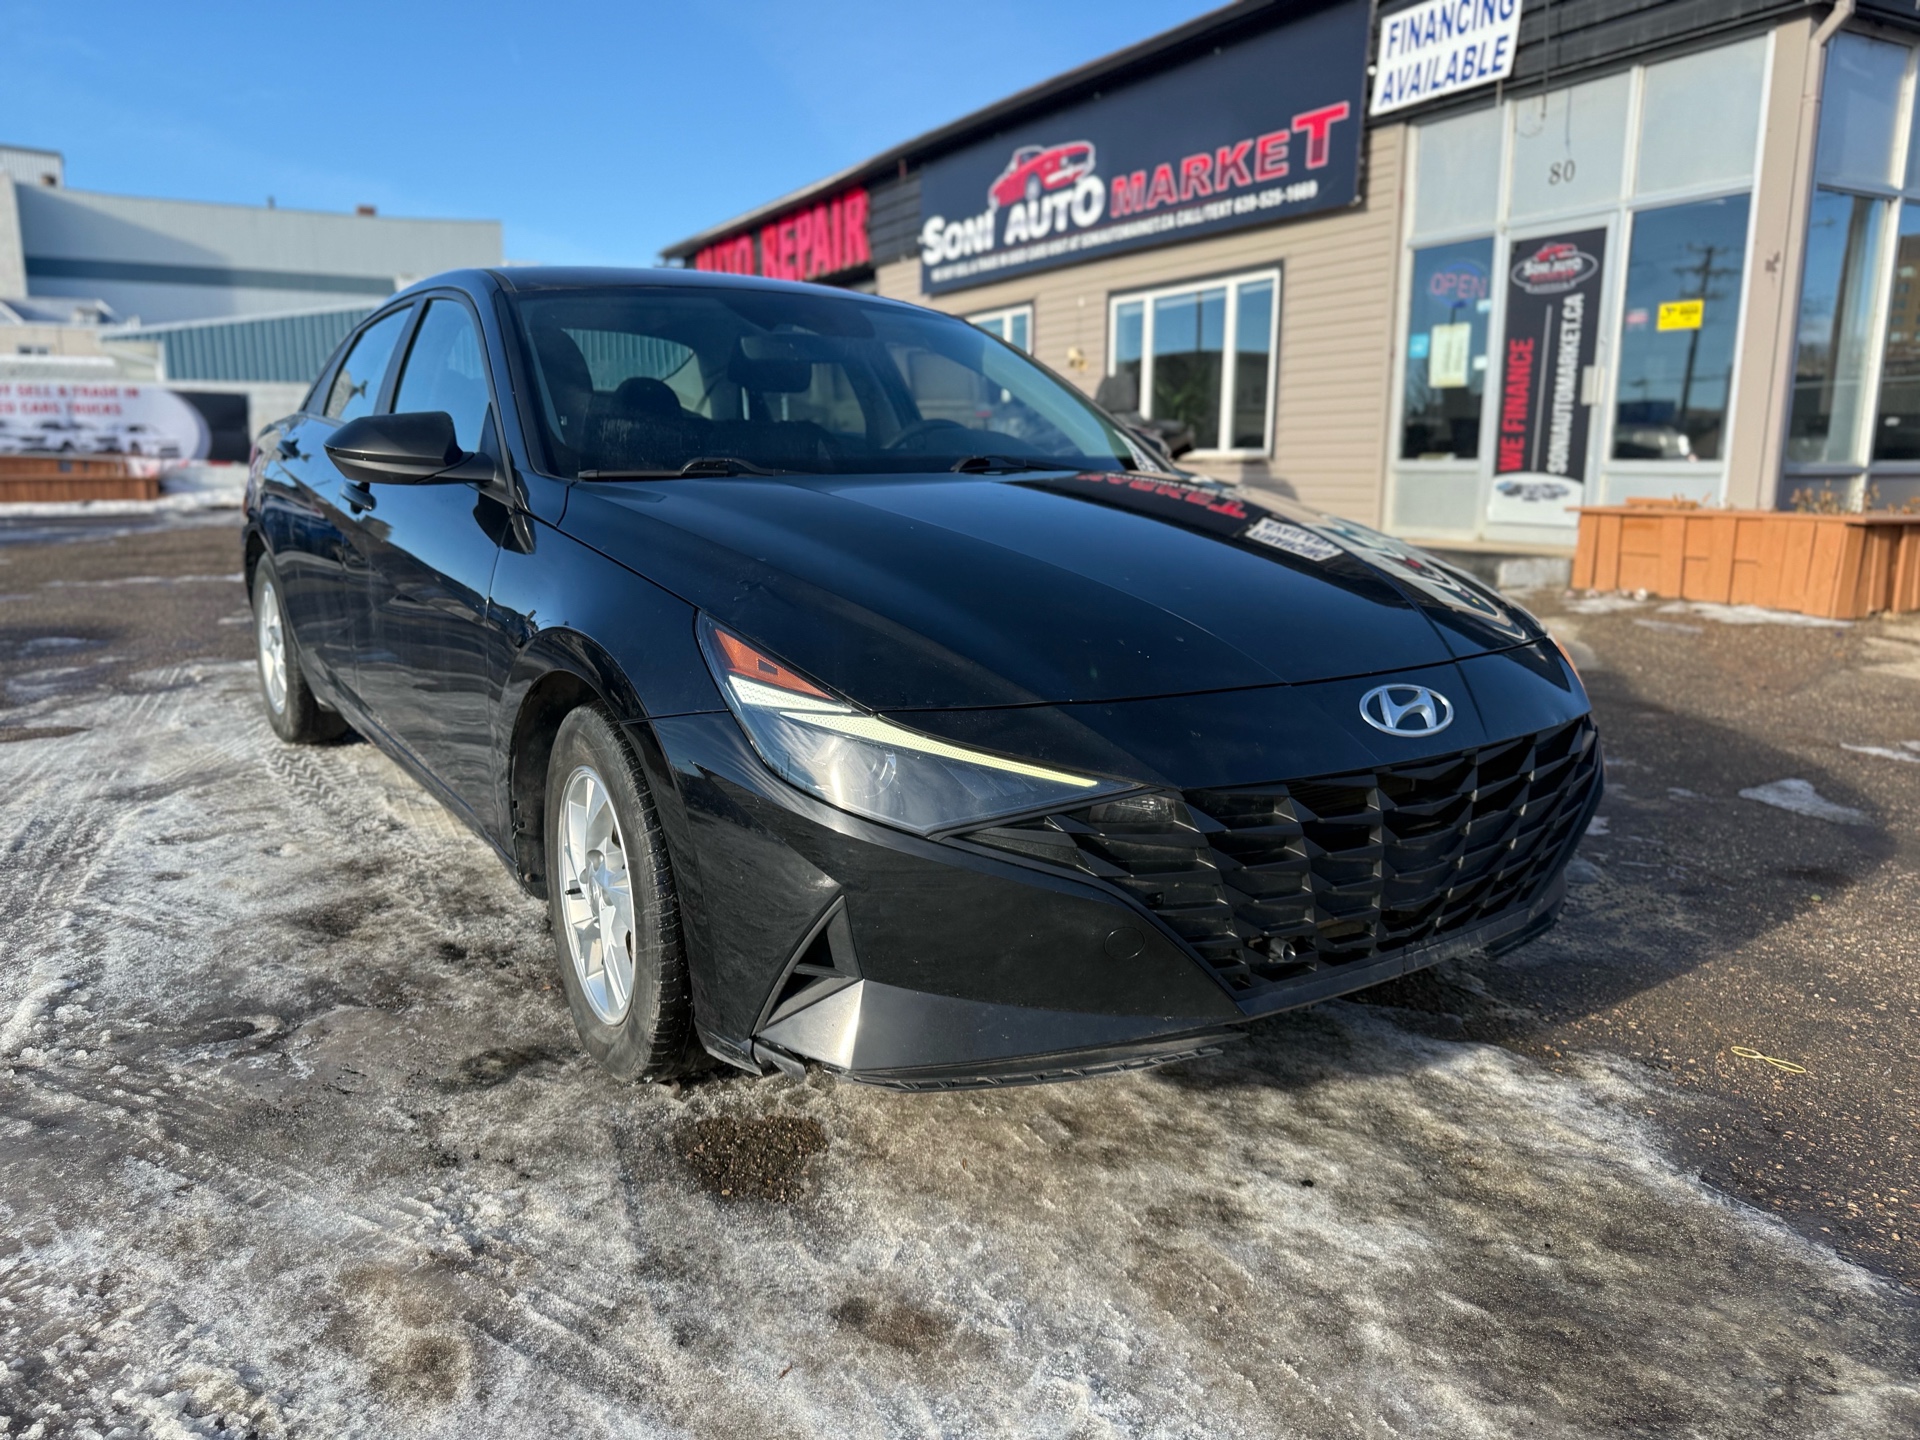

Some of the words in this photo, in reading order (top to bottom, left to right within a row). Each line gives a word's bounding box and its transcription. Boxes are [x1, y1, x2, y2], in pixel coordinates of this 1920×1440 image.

[1387, 0, 1514, 58] FINANCING
[1380, 35, 1509, 106] AVAILABLE
[921, 208, 995, 266] SONI
[1003, 176, 1106, 246] AUTO
[1110, 101, 1350, 218] MARKET
[1548, 159, 1576, 186] 80
[760, 187, 871, 282] REPAIR
[1430, 272, 1487, 299] OPEN
[72, 385, 118, 398] TRADE
[1502, 337, 1534, 433] FINANCE
[1547, 292, 1584, 475] SONIAUTOMARKET.CA
[1498, 436, 1525, 472] WE
